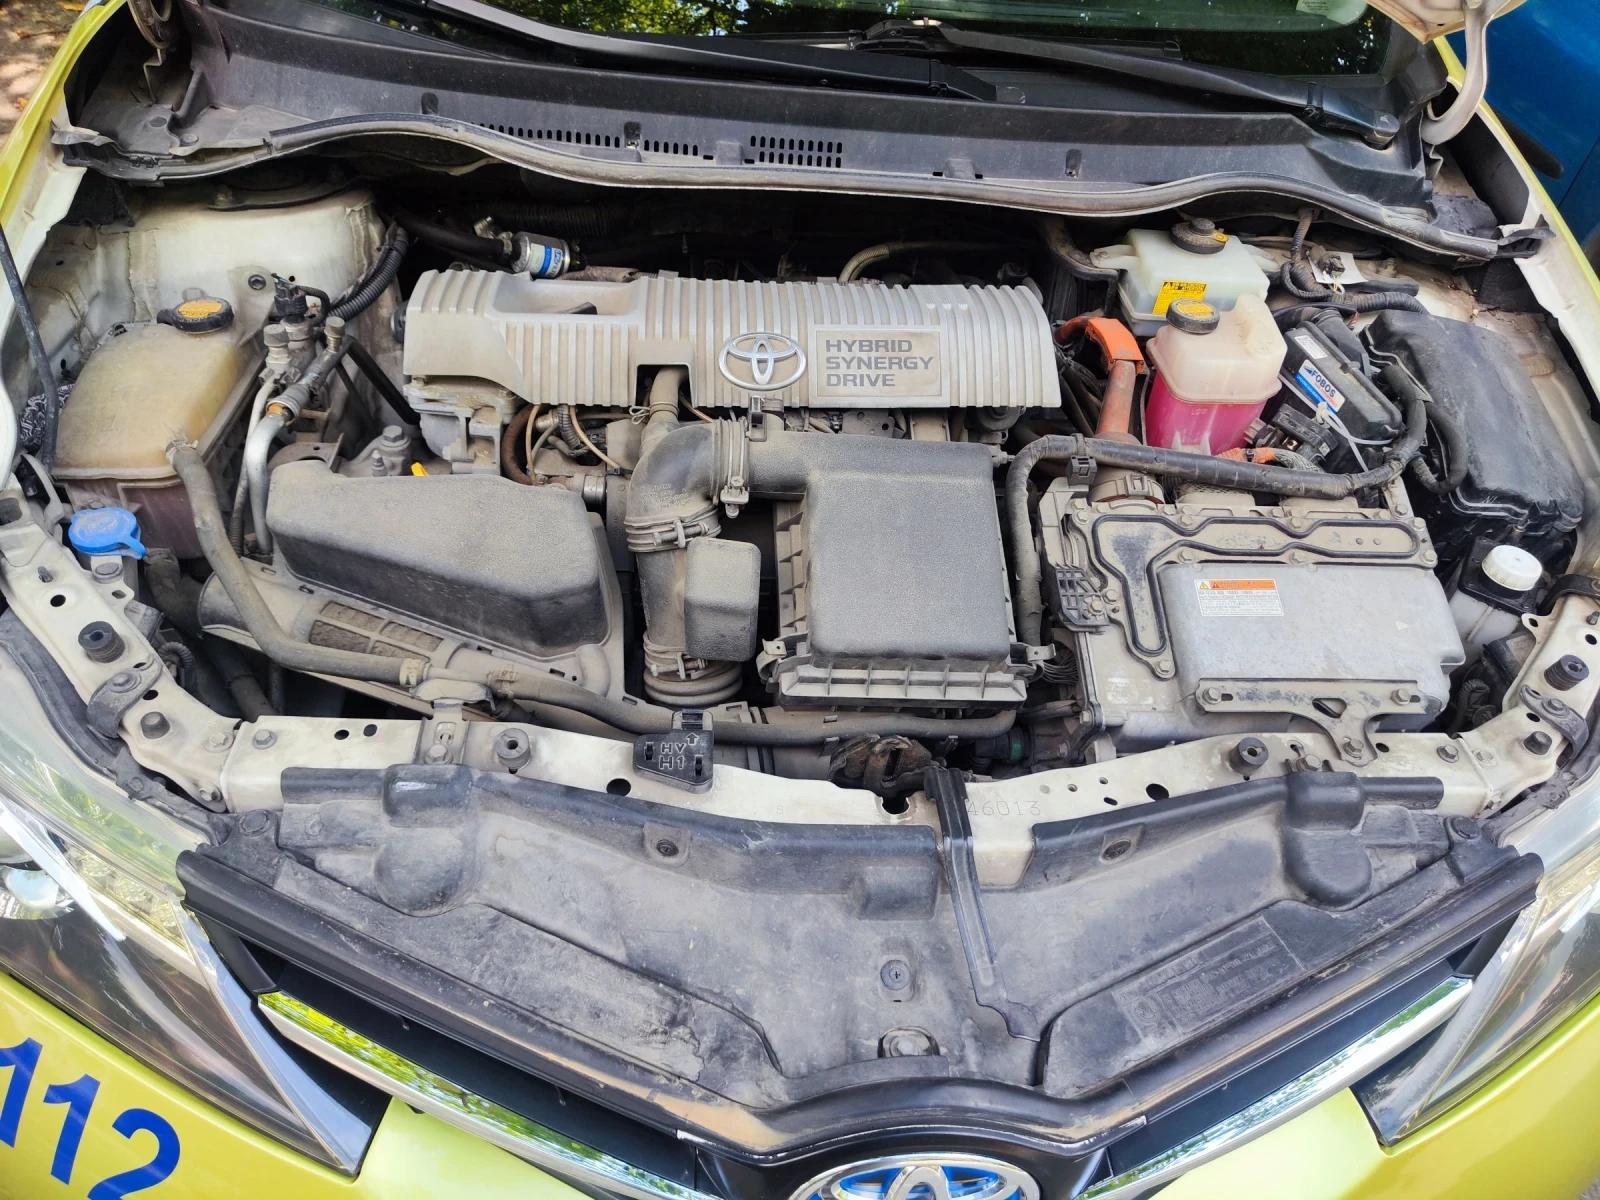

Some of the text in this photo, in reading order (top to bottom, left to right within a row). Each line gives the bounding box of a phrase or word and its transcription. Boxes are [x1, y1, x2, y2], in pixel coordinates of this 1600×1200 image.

[826, 340, 912, 352] HYBRID
[826, 356, 933, 369] SYNERGY
[826, 374, 895, 386] DRIVE
[1311, 369, 1336, 397] FOBOS
[660, 742, 687, 754] HV
[659, 755, 684, 770] H1
[0, 1037, 181, 1200] 112
